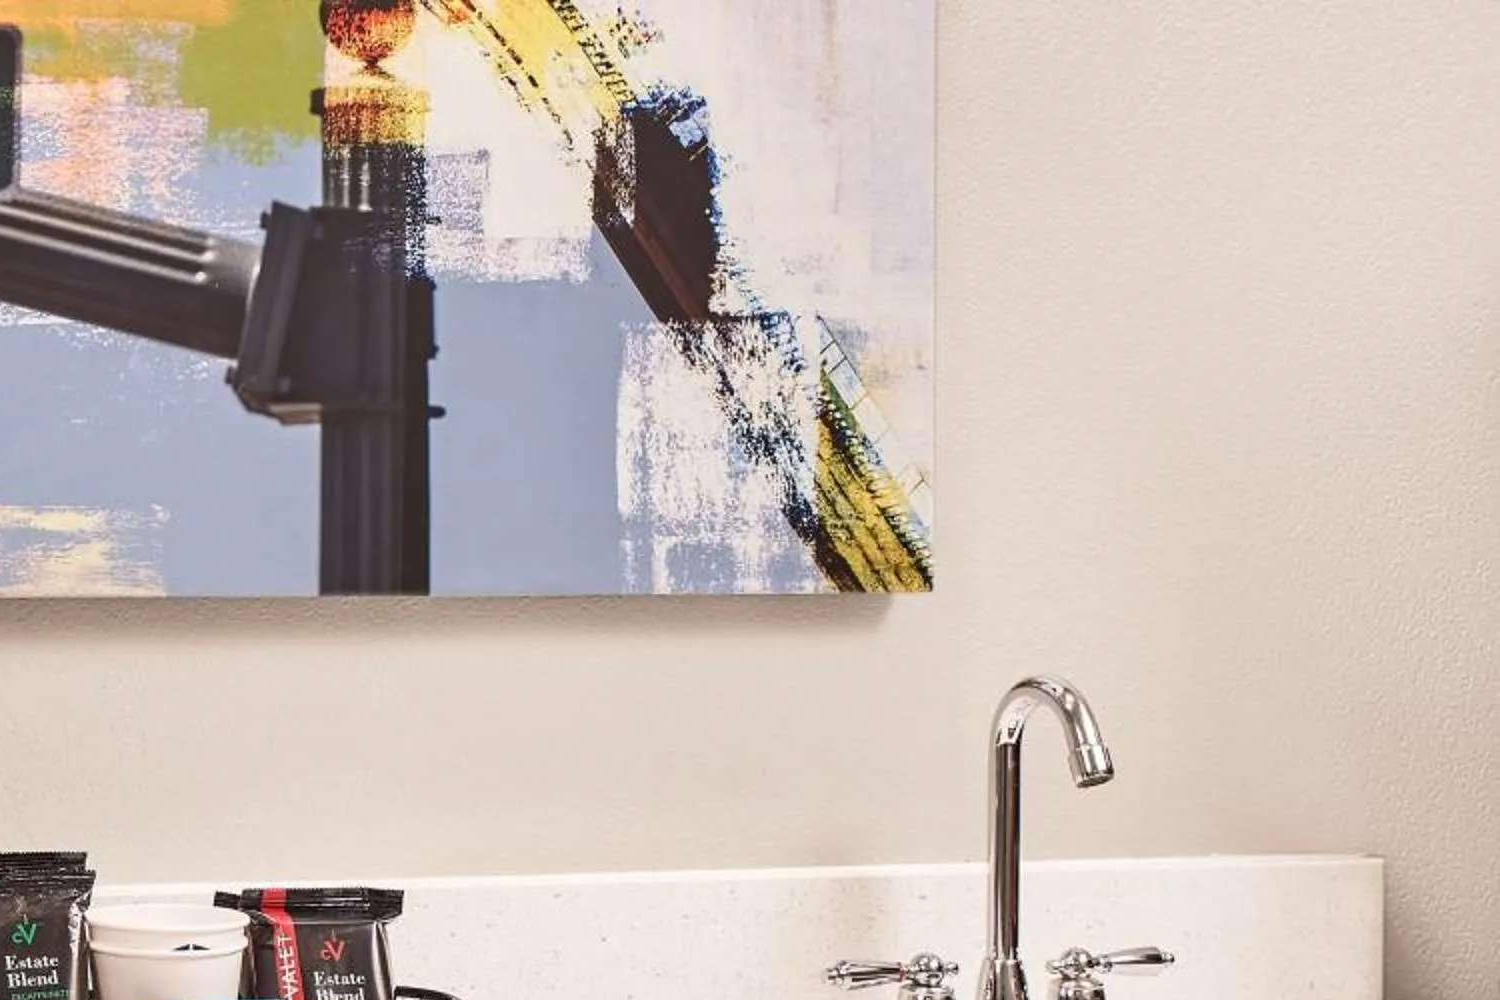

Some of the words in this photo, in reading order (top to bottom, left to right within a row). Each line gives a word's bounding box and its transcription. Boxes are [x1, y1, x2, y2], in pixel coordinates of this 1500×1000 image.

[4, 954, 60, 970] Estate
[6, 969, 60, 989] Blend
[313, 971, 366, 987] Estate
